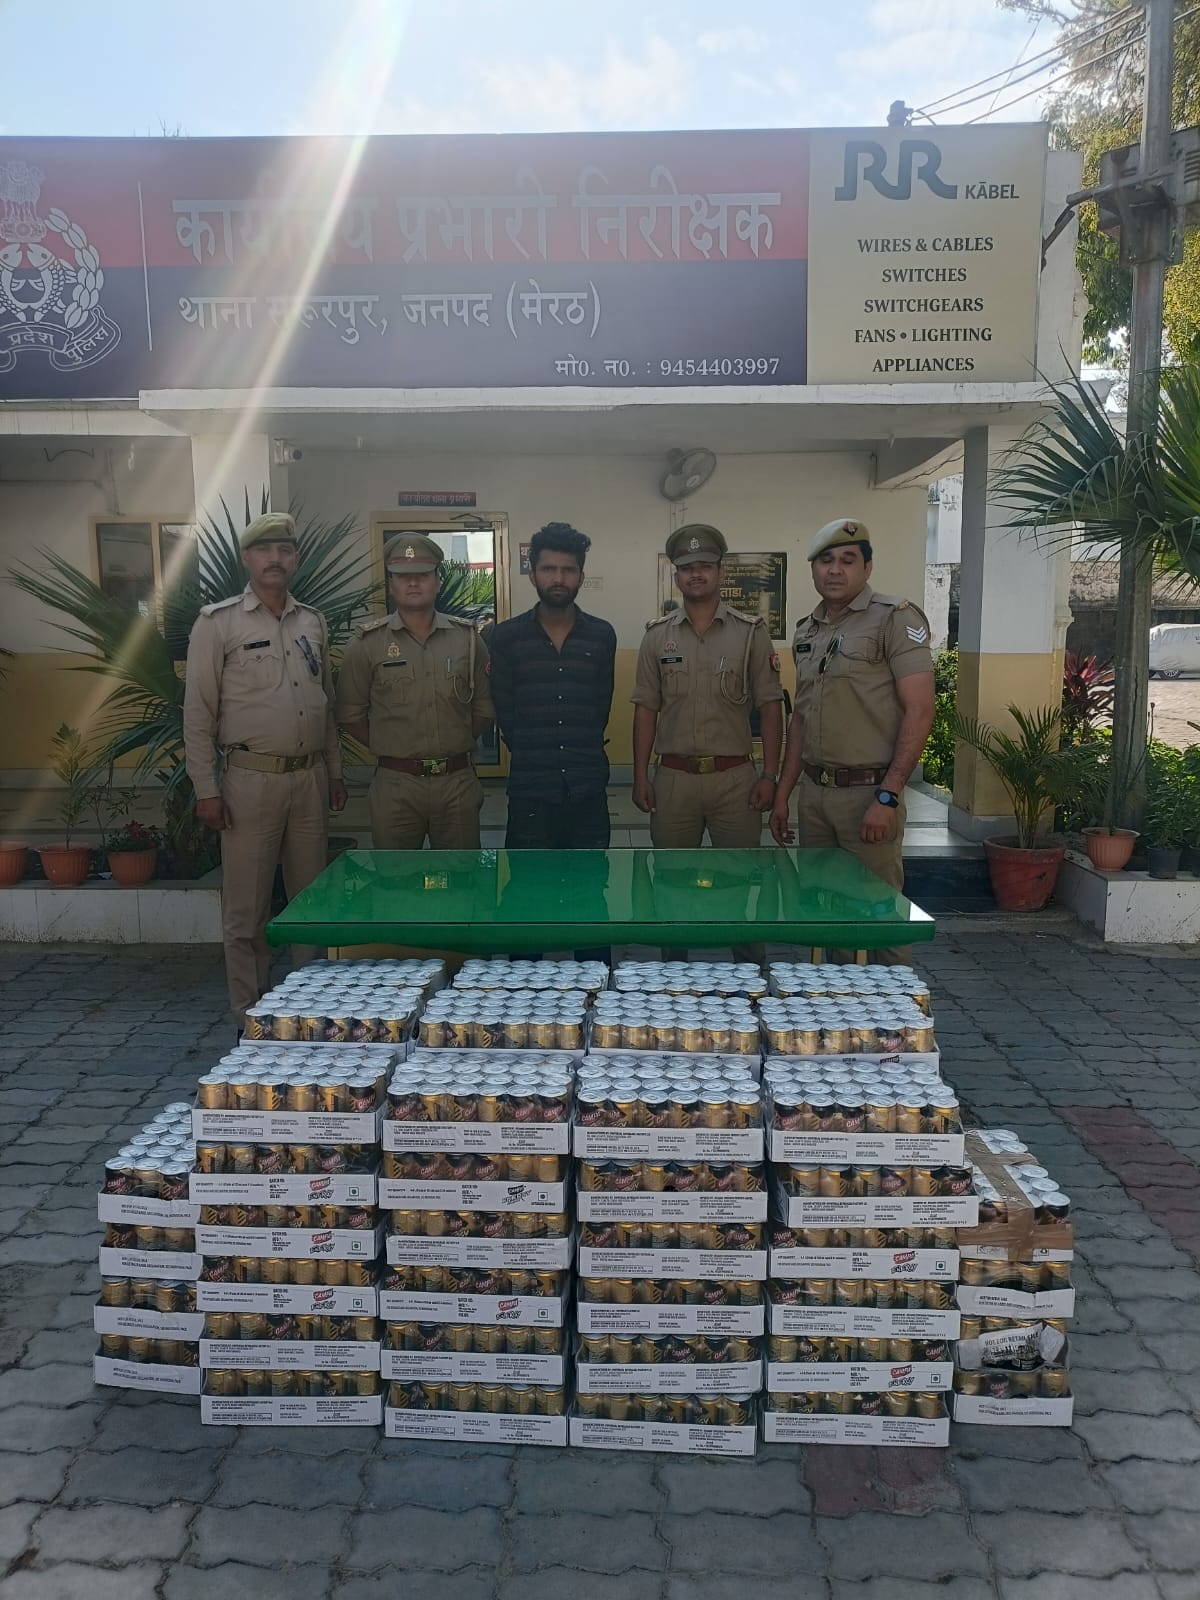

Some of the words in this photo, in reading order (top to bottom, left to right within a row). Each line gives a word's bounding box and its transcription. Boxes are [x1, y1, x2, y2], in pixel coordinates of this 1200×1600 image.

[397, 166, 558, 264] प्रभारी
[571, 165, 781, 260] निरीक्षक
[858, 238, 911, 252] WIRES
[915, 239, 928, 251] &
[932, 237, 994, 251] CABLES
[882, 268, 967, 283] SWITCHES
[179, 296, 256, 329] थाना
[400, 293, 493, 327] जनपद
[506, 277, 600, 339] (मेरठ)
[864, 298, 984, 313] SWITCHGEARS
[8, 326, 55, 346] प्रदेश
[855, 329, 896, 342] FANS
[912, 327, 992, 342] LIGHTING
[64, 326, 109, 362] पुलिस
[660, 358, 780, 376] 9454403997
[872, 358, 975, 372] APPLIANCES
